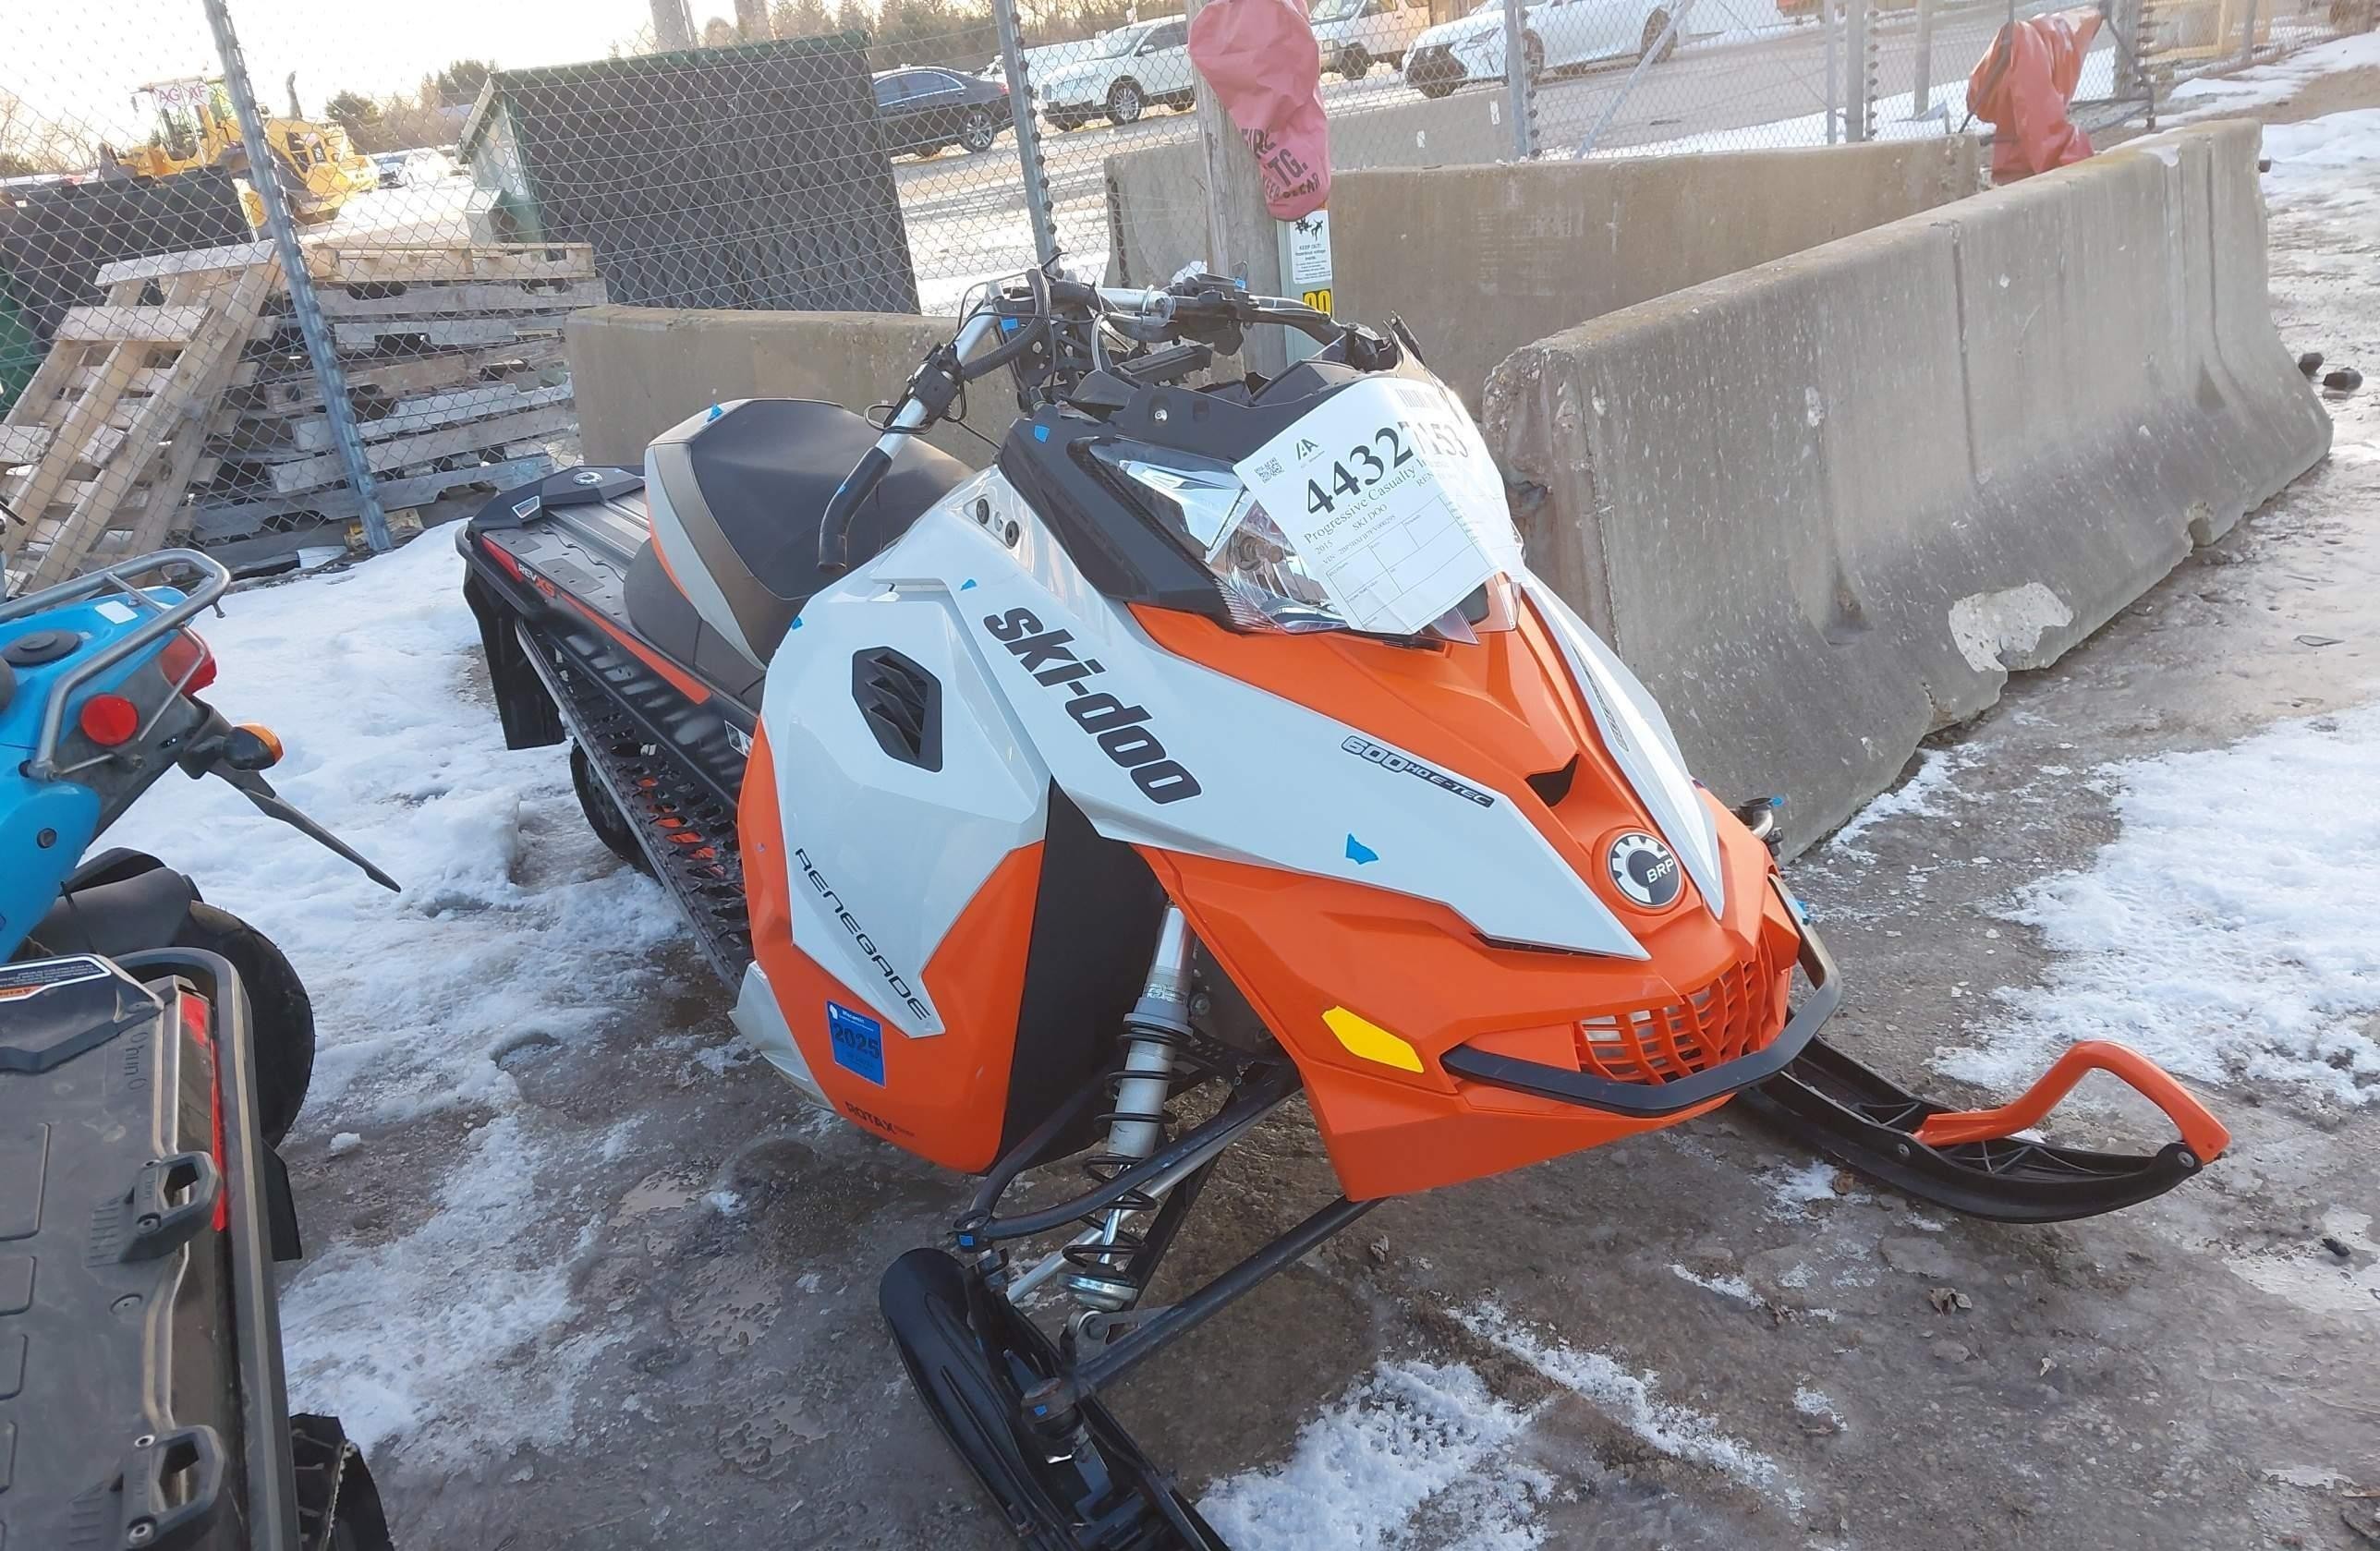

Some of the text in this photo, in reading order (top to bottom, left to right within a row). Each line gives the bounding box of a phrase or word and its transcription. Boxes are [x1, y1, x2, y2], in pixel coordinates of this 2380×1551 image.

[1263, 149, 1308, 187] TG.
[1304, 465, 1416, 543] Progressive Casualty
[1315, 503, 1387, 554] 2015 SKI DOO
[983, 607, 1203, 806] ski-doo
[1341, 735, 1409, 773] 600
[1430, 774, 1492, 806] E-TEC
[1645, 858, 1675, 884] BRP
[795, 848, 930, 1021] RENEGADE
[832, 1022, 880, 1059] 2025
[844, 1100, 896, 1134] ROTAX
